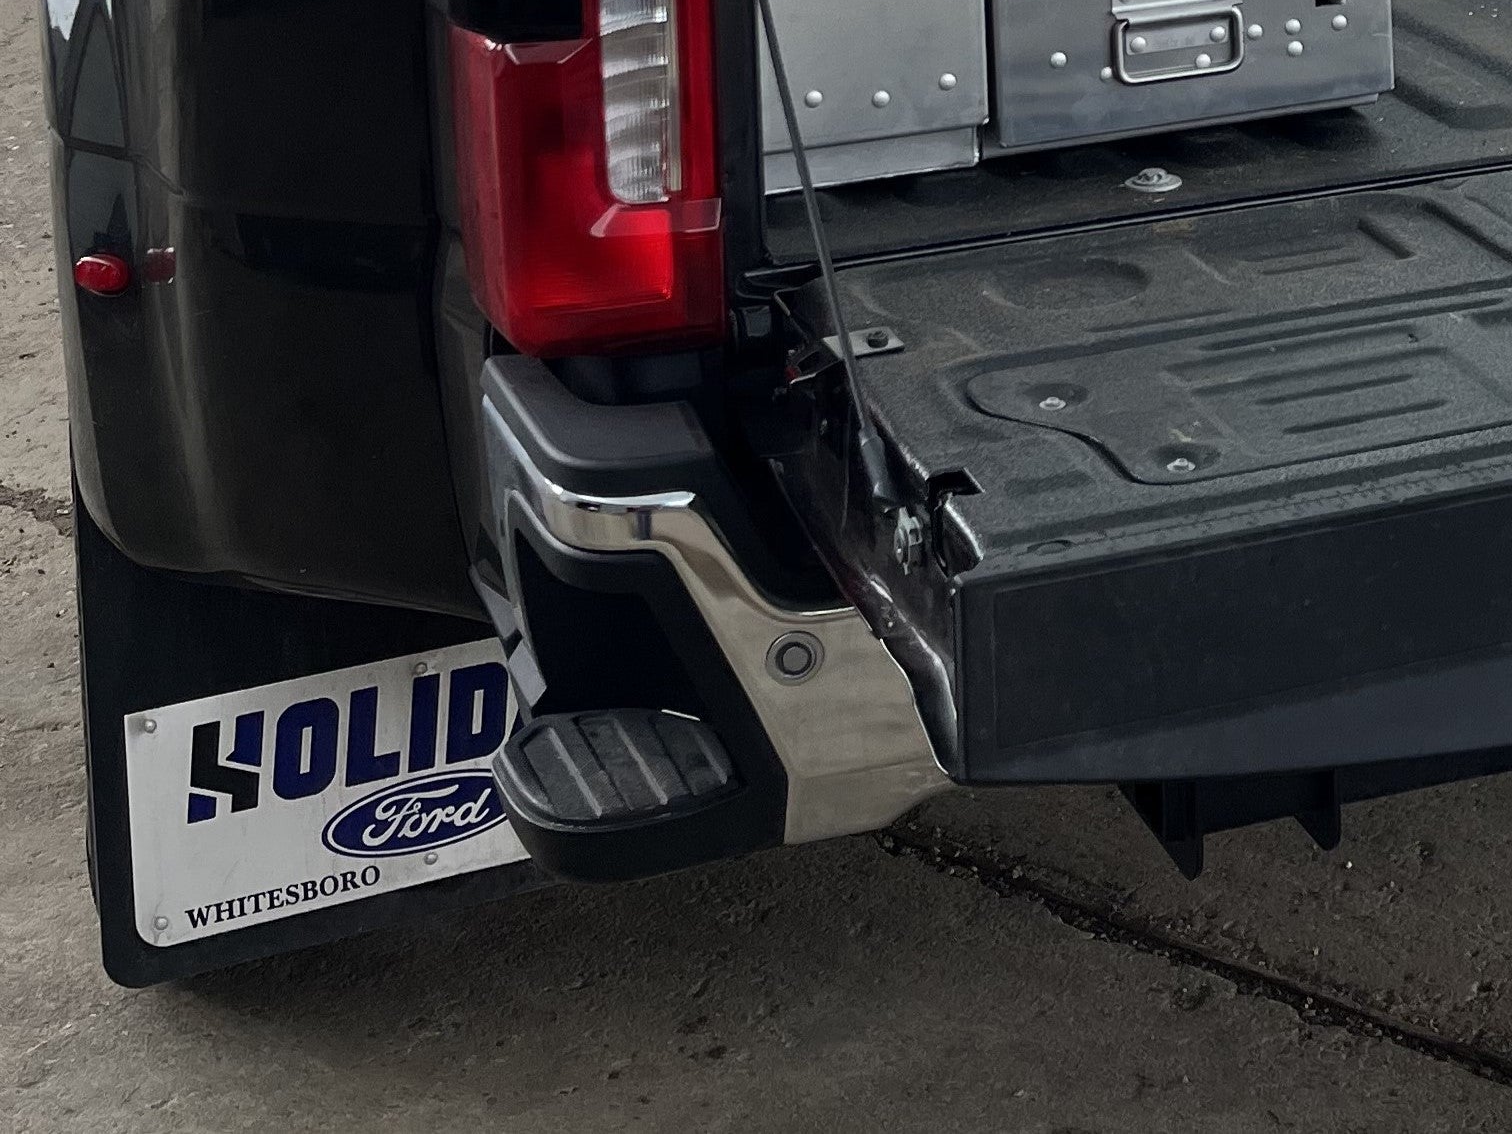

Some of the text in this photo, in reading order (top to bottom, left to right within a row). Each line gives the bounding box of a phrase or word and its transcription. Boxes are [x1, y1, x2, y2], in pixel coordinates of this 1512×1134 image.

[187, 661, 524, 825] HOLID
[361, 783, 492, 848] Ford
[185, 865, 381, 929] WHITESBORO
